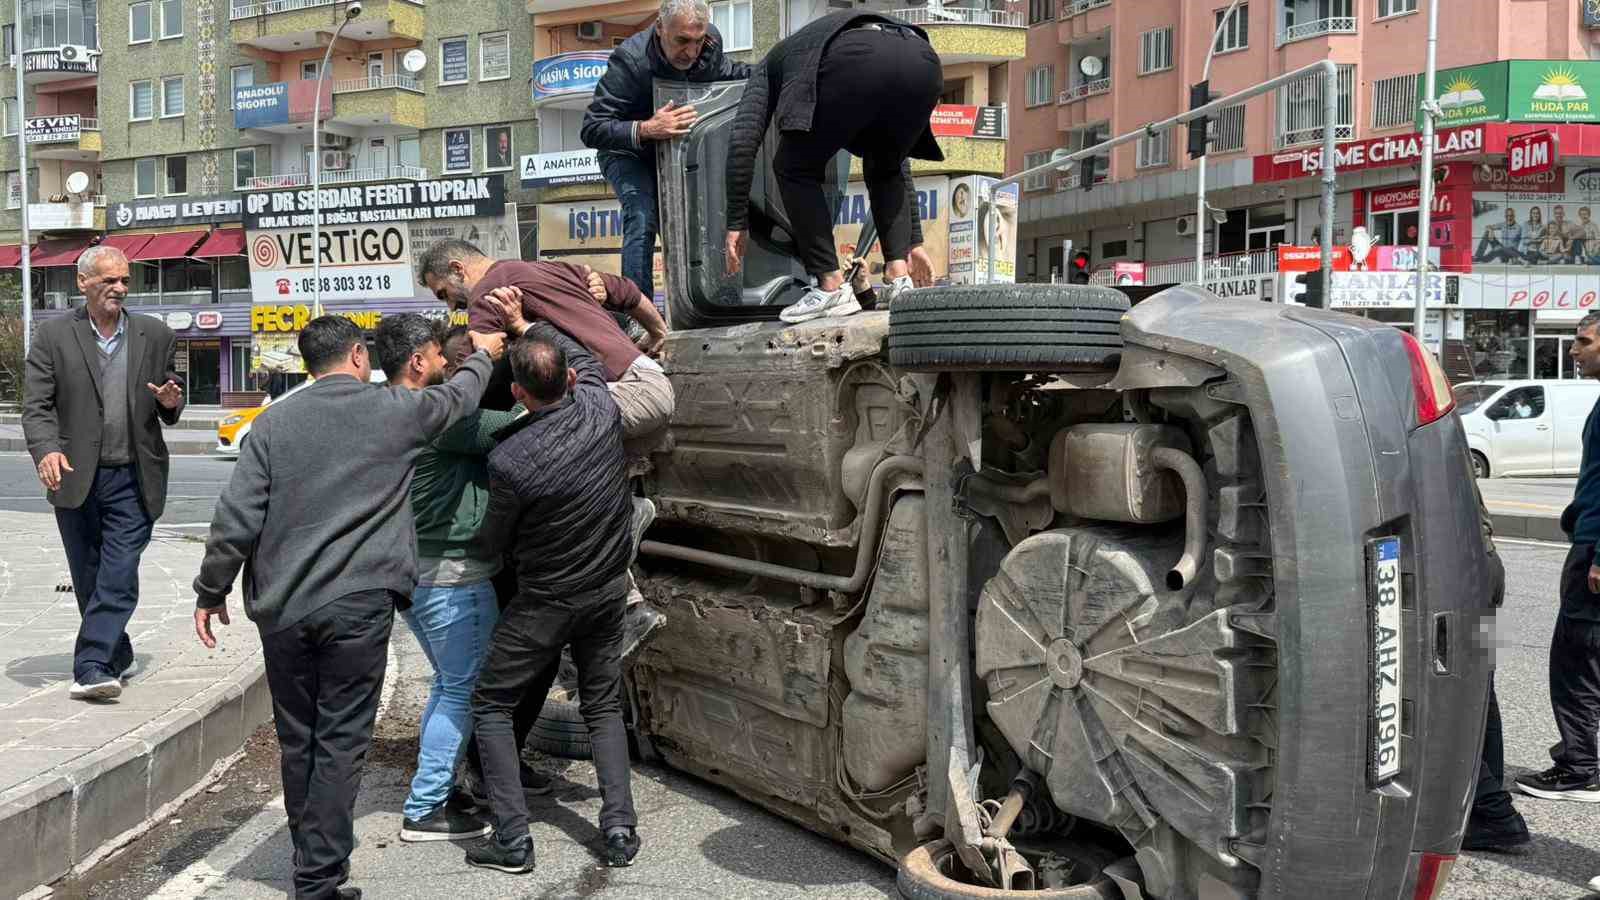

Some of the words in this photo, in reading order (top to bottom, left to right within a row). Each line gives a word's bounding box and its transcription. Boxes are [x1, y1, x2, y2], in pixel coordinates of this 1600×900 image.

[237, 85, 285, 99] ANADOLU
[1465, 105, 1487, 117] PAR
[1567, 102, 1589, 112] PAR
[1302, 147, 1366, 176] İŞİME
[1368, 128, 1482, 162] CİHALARI
[1511, 139, 1549, 171] BİM
[544, 157, 591, 170] ANAHTAR
[1579, 175, 1600, 191] SG
[247, 194, 269, 214] OP
[272, 192, 295, 212] DR
[298, 187, 363, 211] SERDAR
[418, 177, 490, 203] TOPRAK
[258, 216, 290, 229] KULAK
[291, 213, 325, 226] BURN
[326, 209, 359, 224] BOĞAZ
[433, 204, 476, 218] UZMANI
[333, 276, 355, 292] 303
[358, 275, 374, 291] 32
[376, 274, 392, 290] 18
[1378, 544, 1385, 560] TR
[1377, 564, 1396, 607] 38
[1378, 626, 1398, 688] AHZ
[1378, 702, 1397, 766] 096
